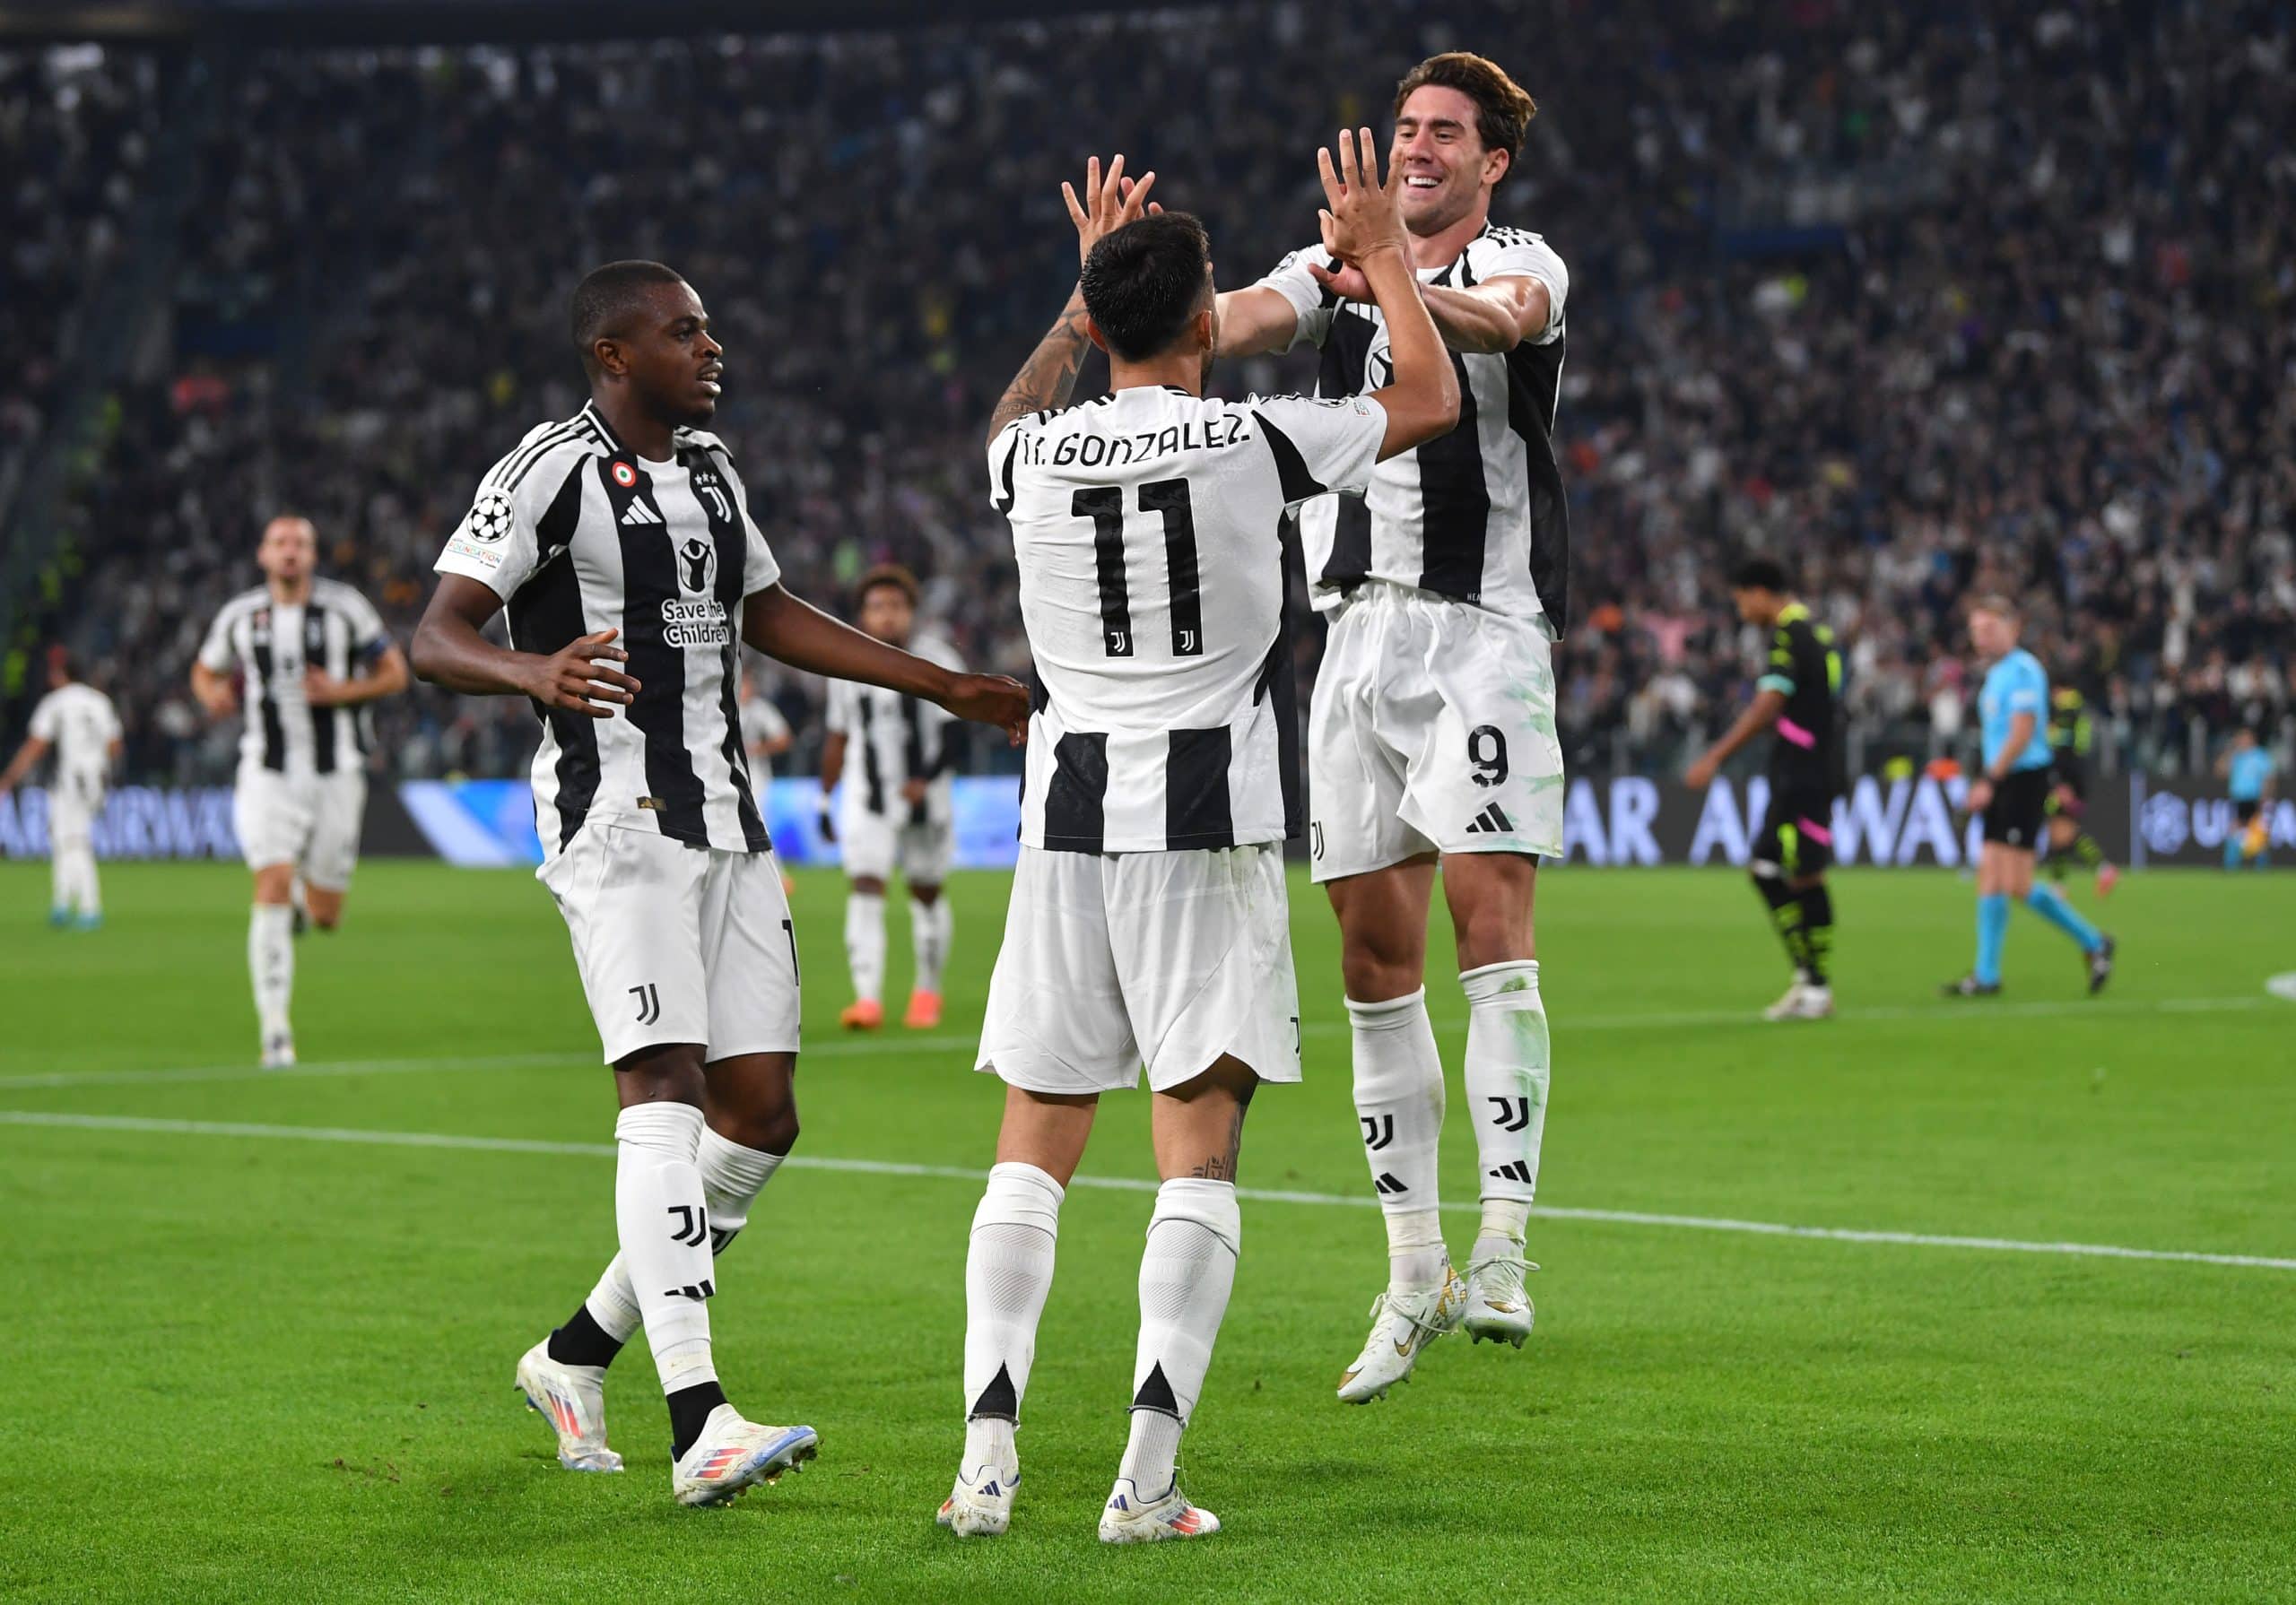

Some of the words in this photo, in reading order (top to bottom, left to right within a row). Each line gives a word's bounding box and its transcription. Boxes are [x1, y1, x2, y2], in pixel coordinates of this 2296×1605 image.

[1071, 477, 1203, 657] 11
[664, 600, 705, 620] Save
[665, 624, 728, 645] Children
[1467, 724, 1509, 787] 9
